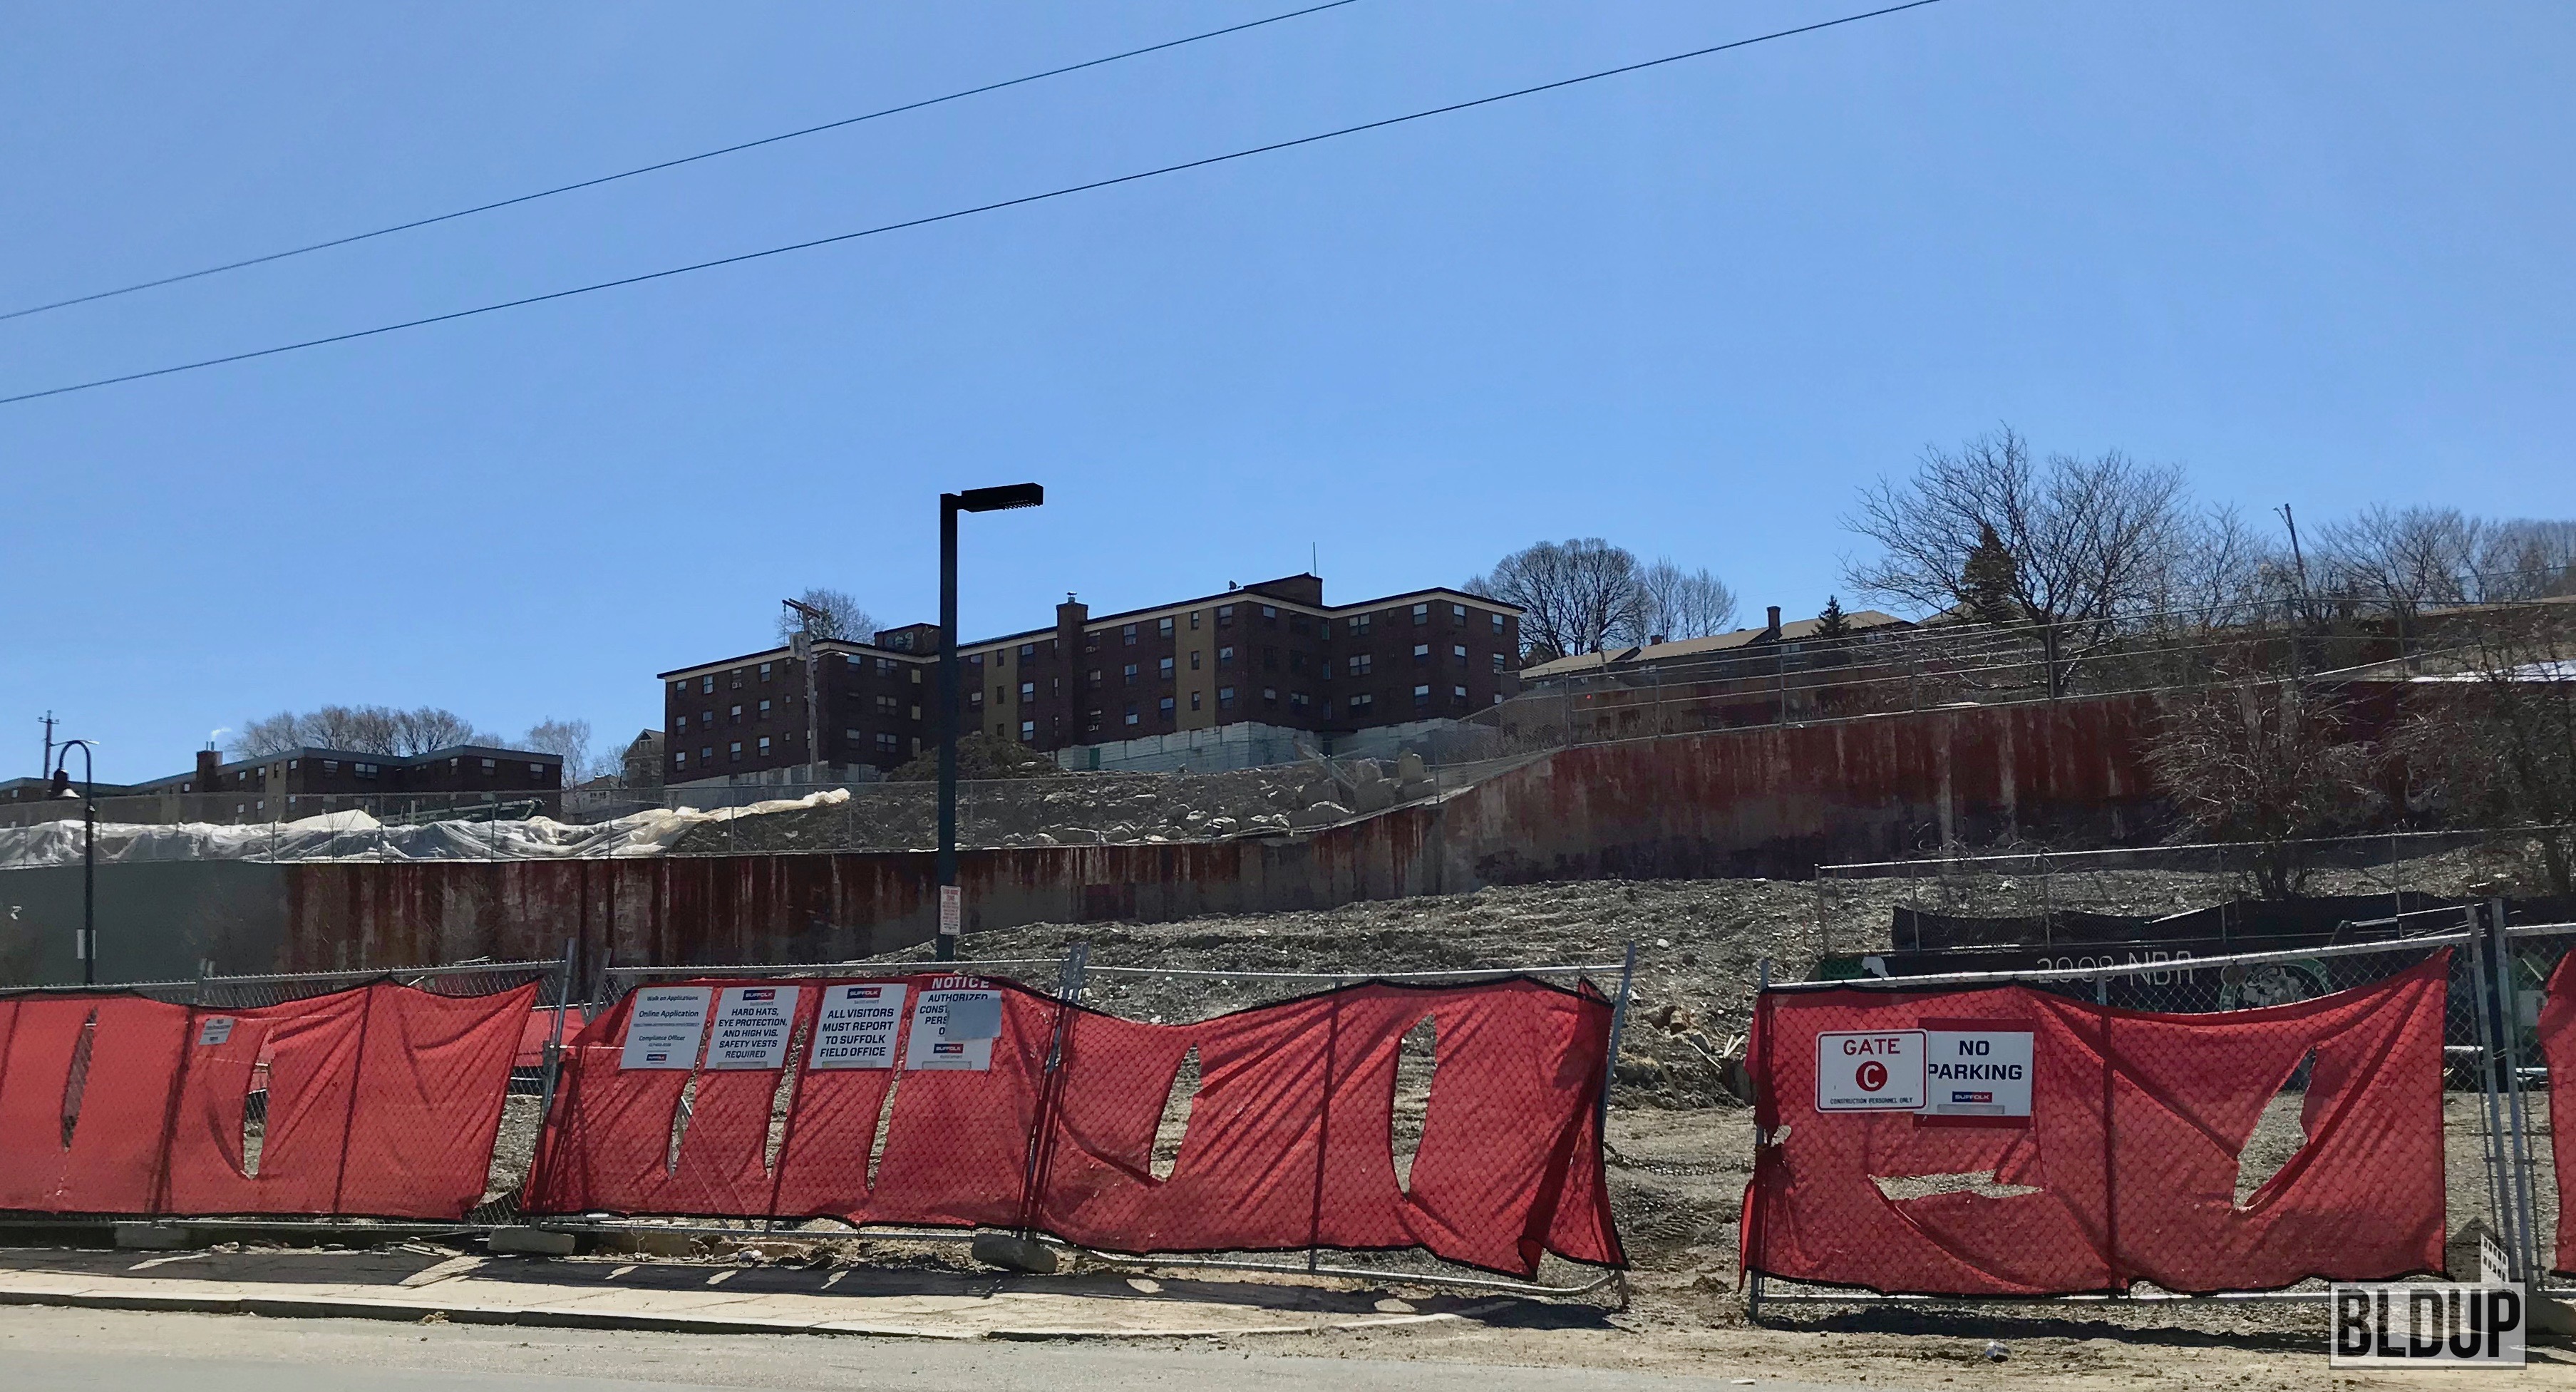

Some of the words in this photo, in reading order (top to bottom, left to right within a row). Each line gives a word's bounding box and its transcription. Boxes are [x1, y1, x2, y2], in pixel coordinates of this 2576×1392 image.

[932, 976, 989, 989] NOTICE
[660, 1009, 699, 1019] Application
[756, 1008, 779, 1016] HATS,
[828, 1009, 845, 1019] ALL
[847, 1008, 895, 1018] VISITORS
[822, 1022, 851, 1031] MUST
[852, 1021, 894, 1031] REPORT
[825, 1036, 838, 1044] TO
[840, 1034, 886, 1044] SUFFOLK
[820, 1048, 848, 1057] FIELD
[850, 1047, 886, 1056] OFFICE
[1843, 1038, 1901, 1056] GATE
[1959, 1040, 1990, 1056] NO
[1863, 1065, 1880, 1088] C
[1928, 1063, 2023, 1080] PARKING
